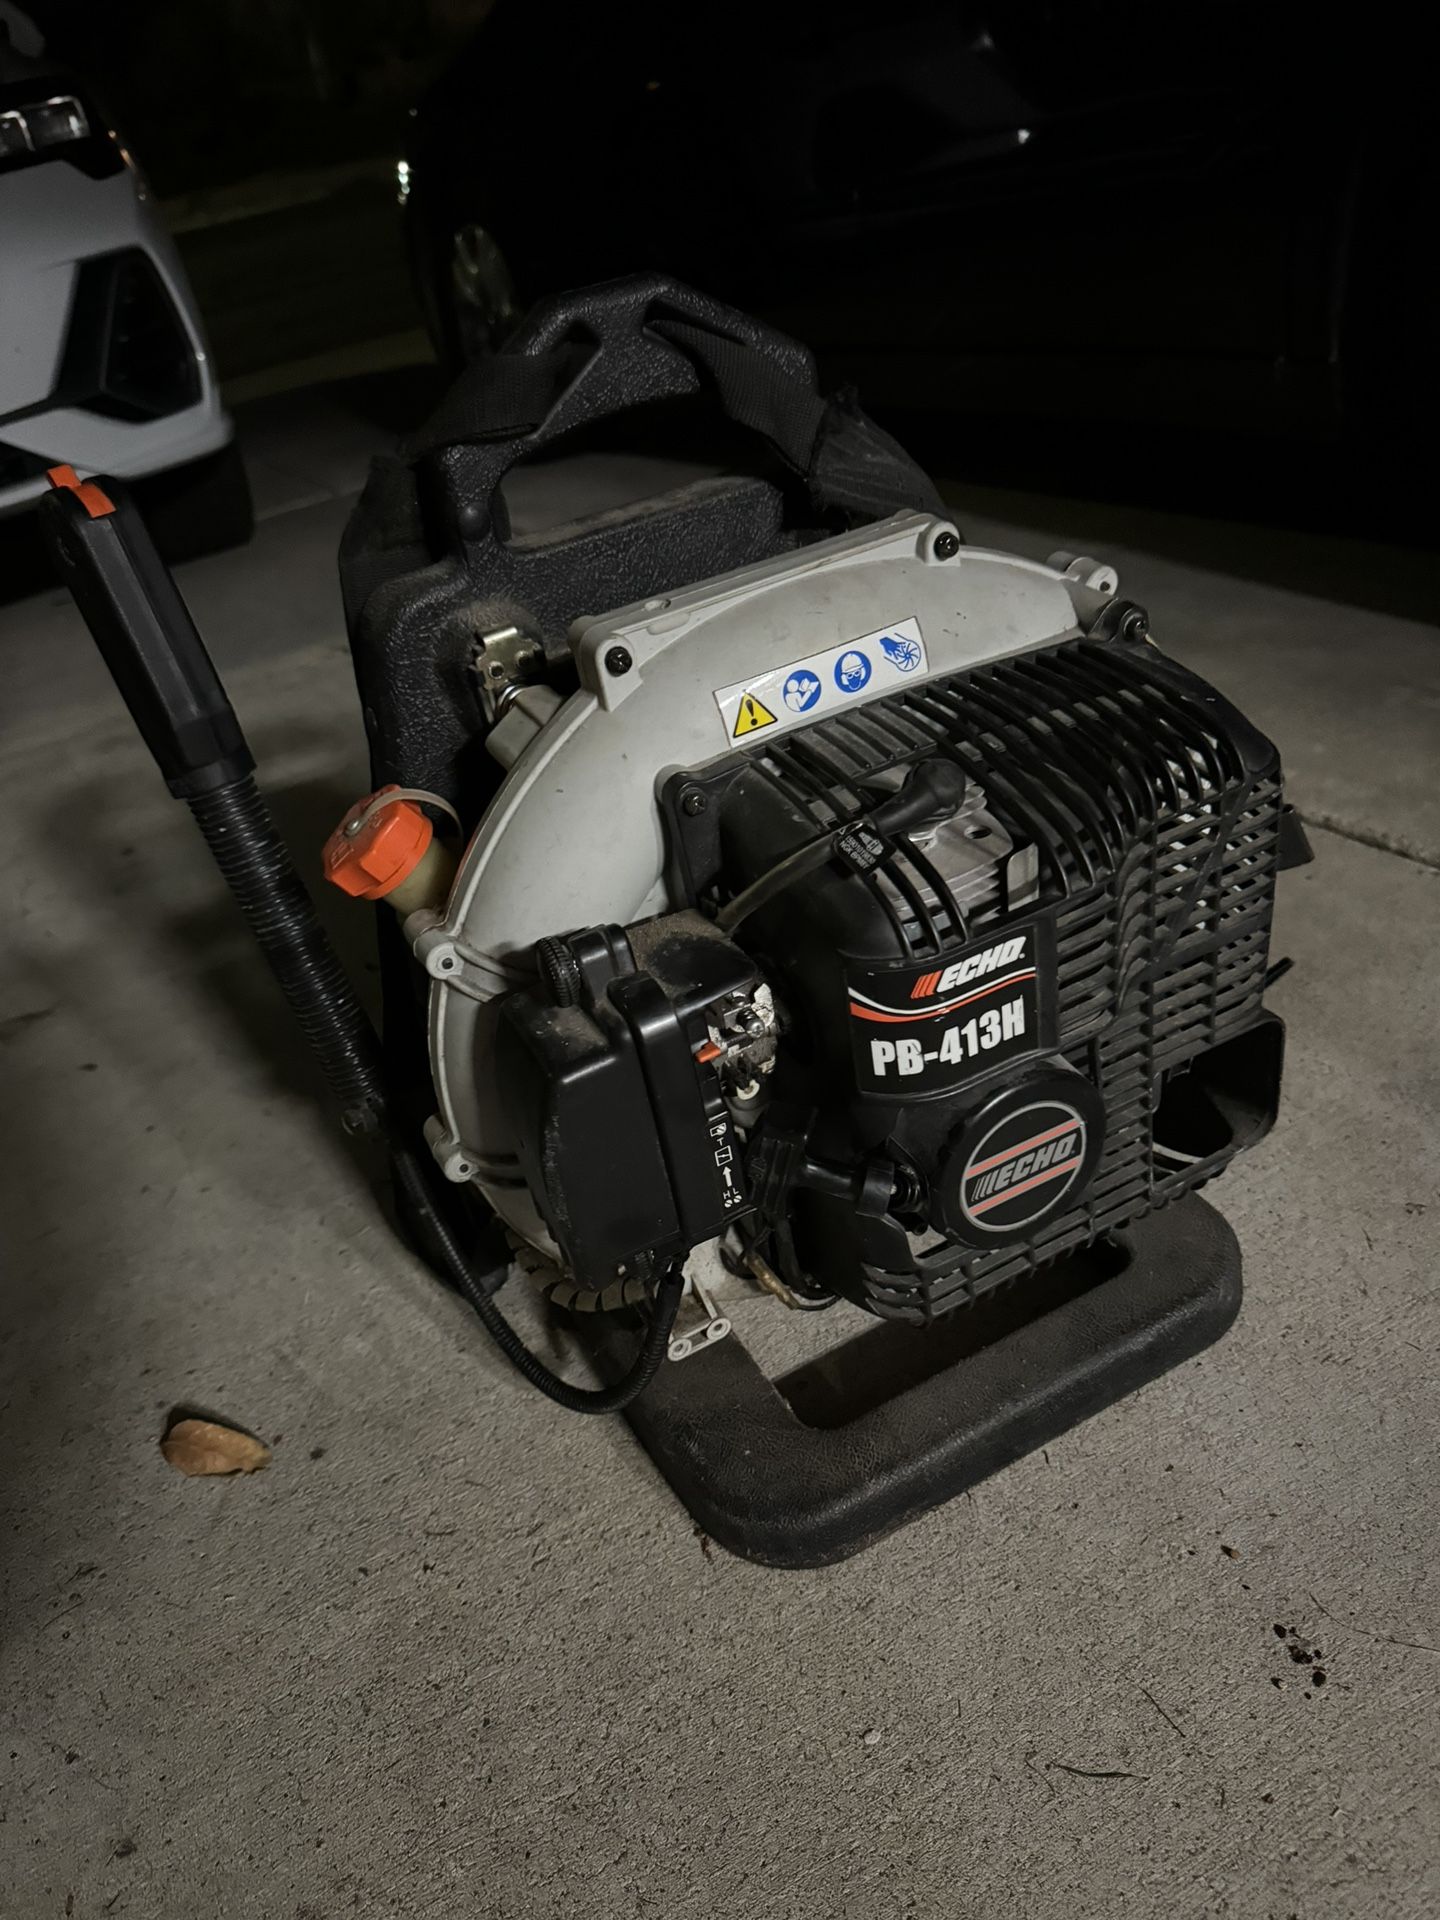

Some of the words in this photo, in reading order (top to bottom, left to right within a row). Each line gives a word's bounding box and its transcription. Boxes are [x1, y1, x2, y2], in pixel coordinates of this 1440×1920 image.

[839, 840, 853, 855] NGK
[936, 936, 1026, 993] ECHO
[870, 995, 1026, 1076] PB-413H
[991, 1132, 1077, 1191] ECHO
[722, 1190, 731, 1200] H
[732, 1187, 740, 1195] L
